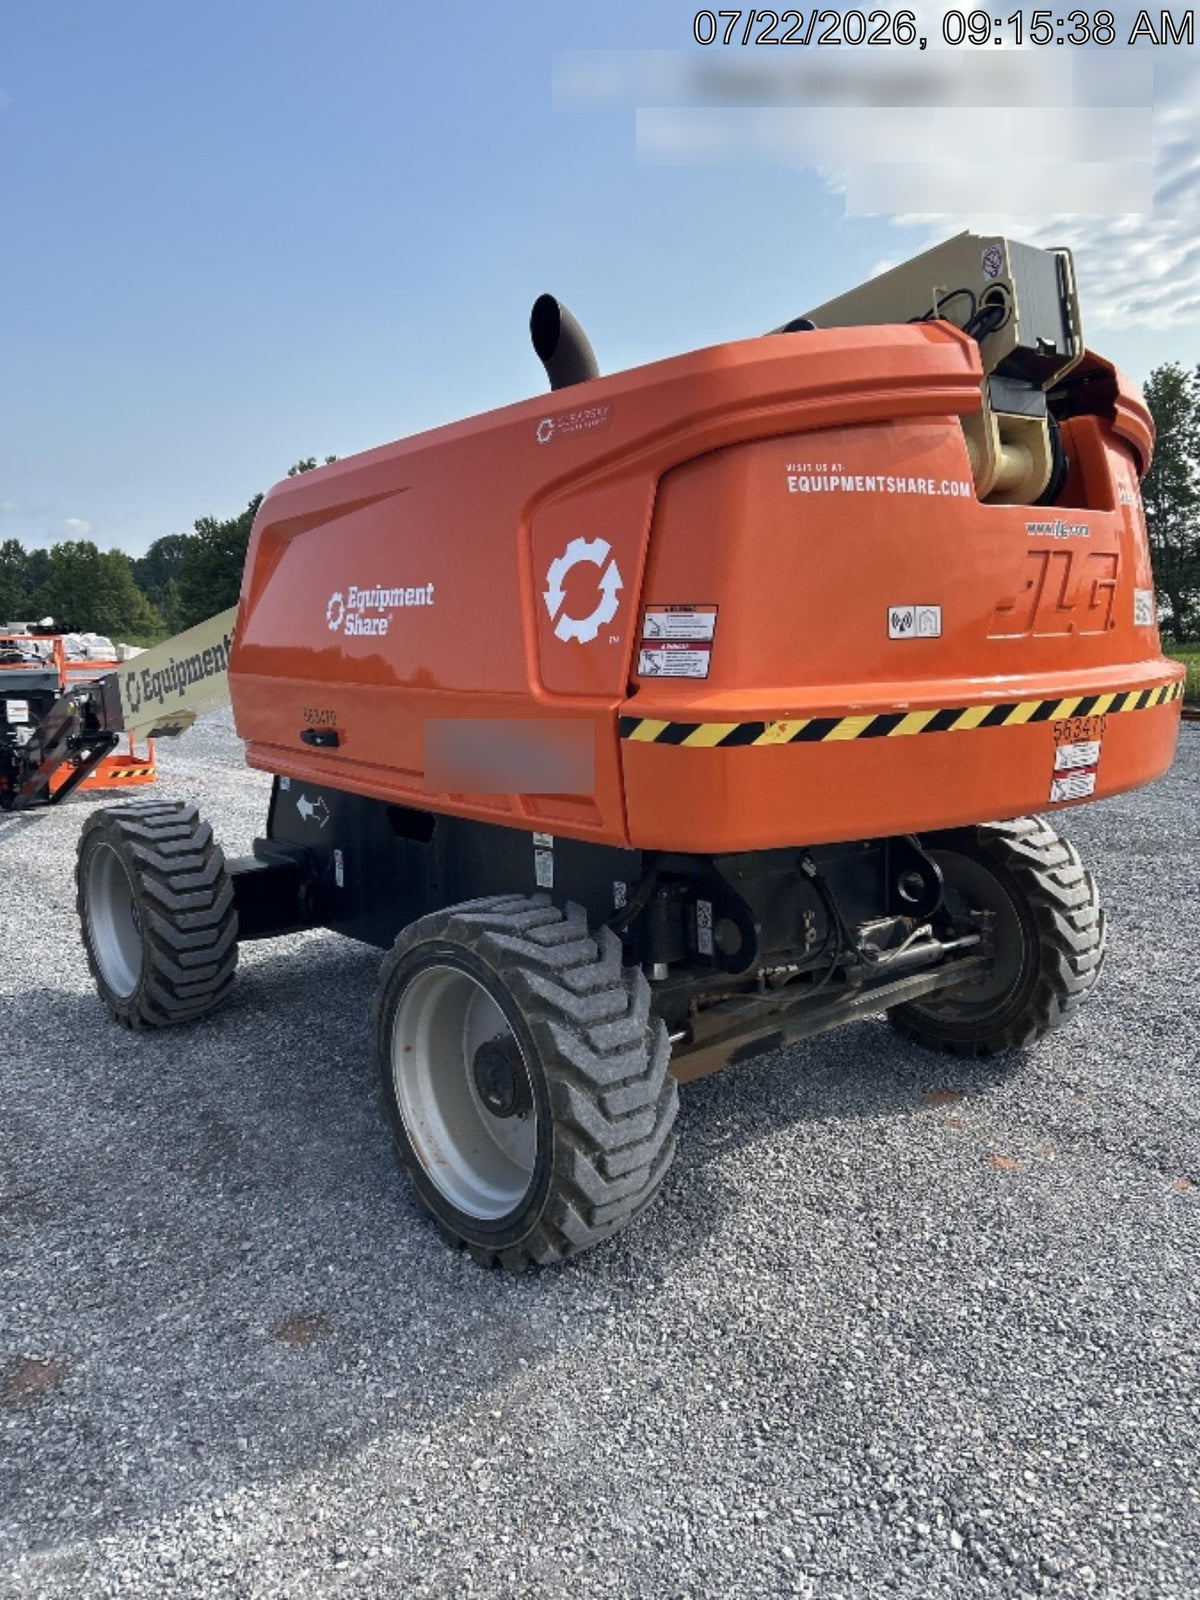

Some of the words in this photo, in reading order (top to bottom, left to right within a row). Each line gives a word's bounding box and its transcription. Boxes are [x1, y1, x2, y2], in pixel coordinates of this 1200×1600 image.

[786, 463, 812, 472] VISIT
[815, 464, 828, 472] US
[787, 475, 971, 498] EQUIPMENTSHARE.COM
[346, 582, 435, 613] Equipment
[985, 550, 1120, 639] JLG
[141, 634, 232, 704] Equipment
